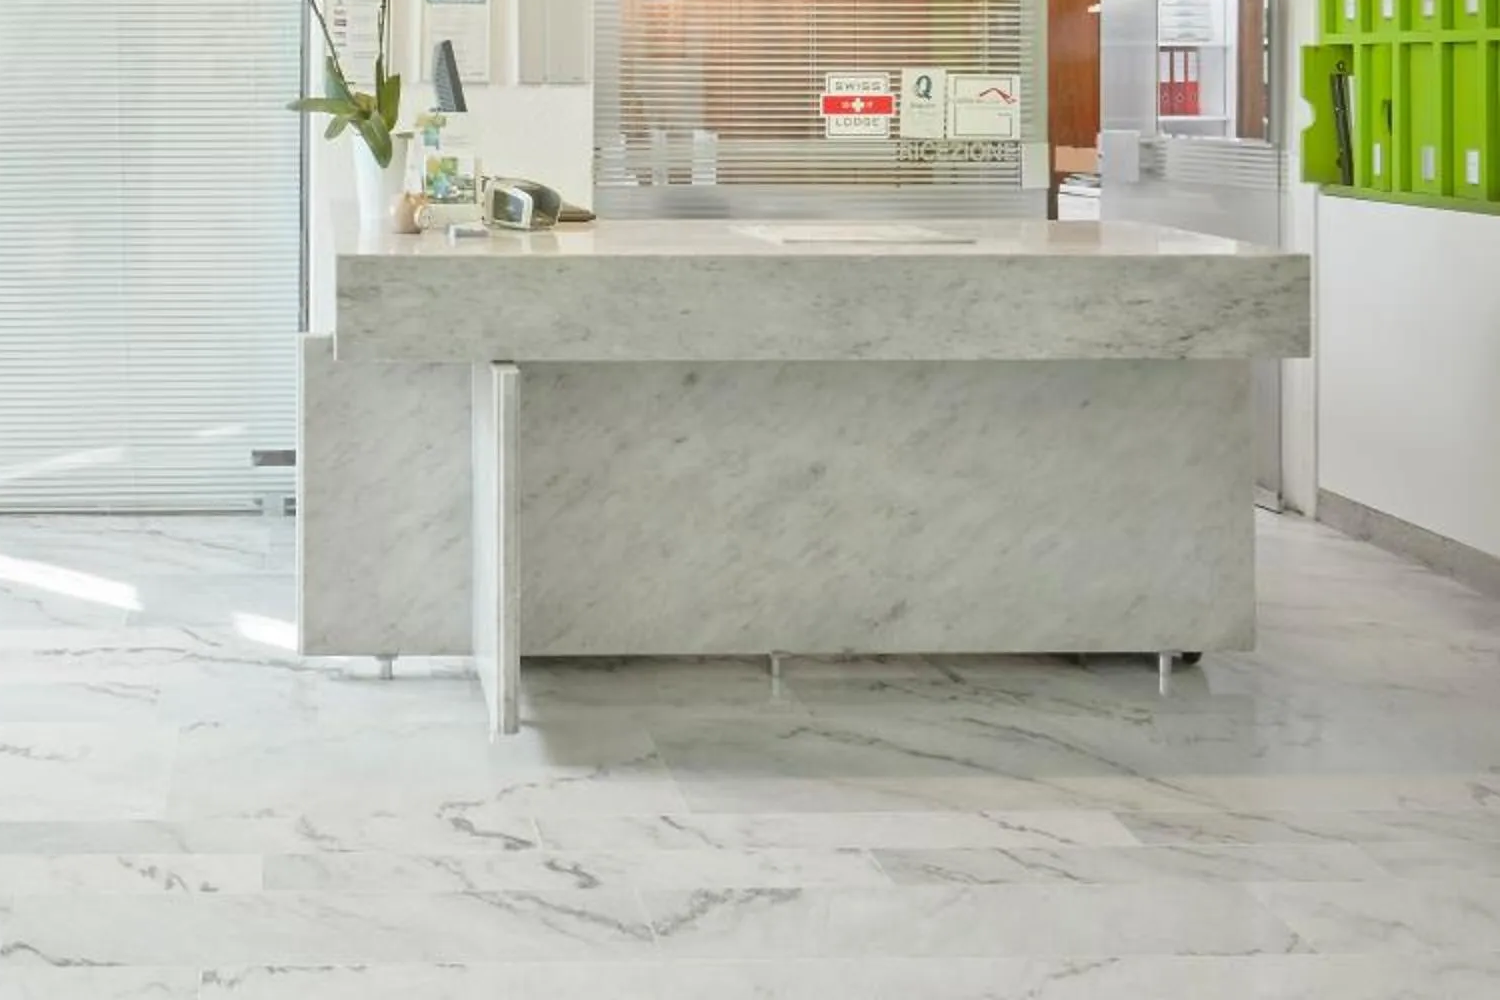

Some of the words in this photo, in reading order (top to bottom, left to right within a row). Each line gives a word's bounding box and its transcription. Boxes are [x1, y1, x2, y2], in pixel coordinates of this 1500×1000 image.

[835, 81, 881, 91] SWISS
[915, 74, 933, 100] Q
[835, 117, 881, 127] LODGE
